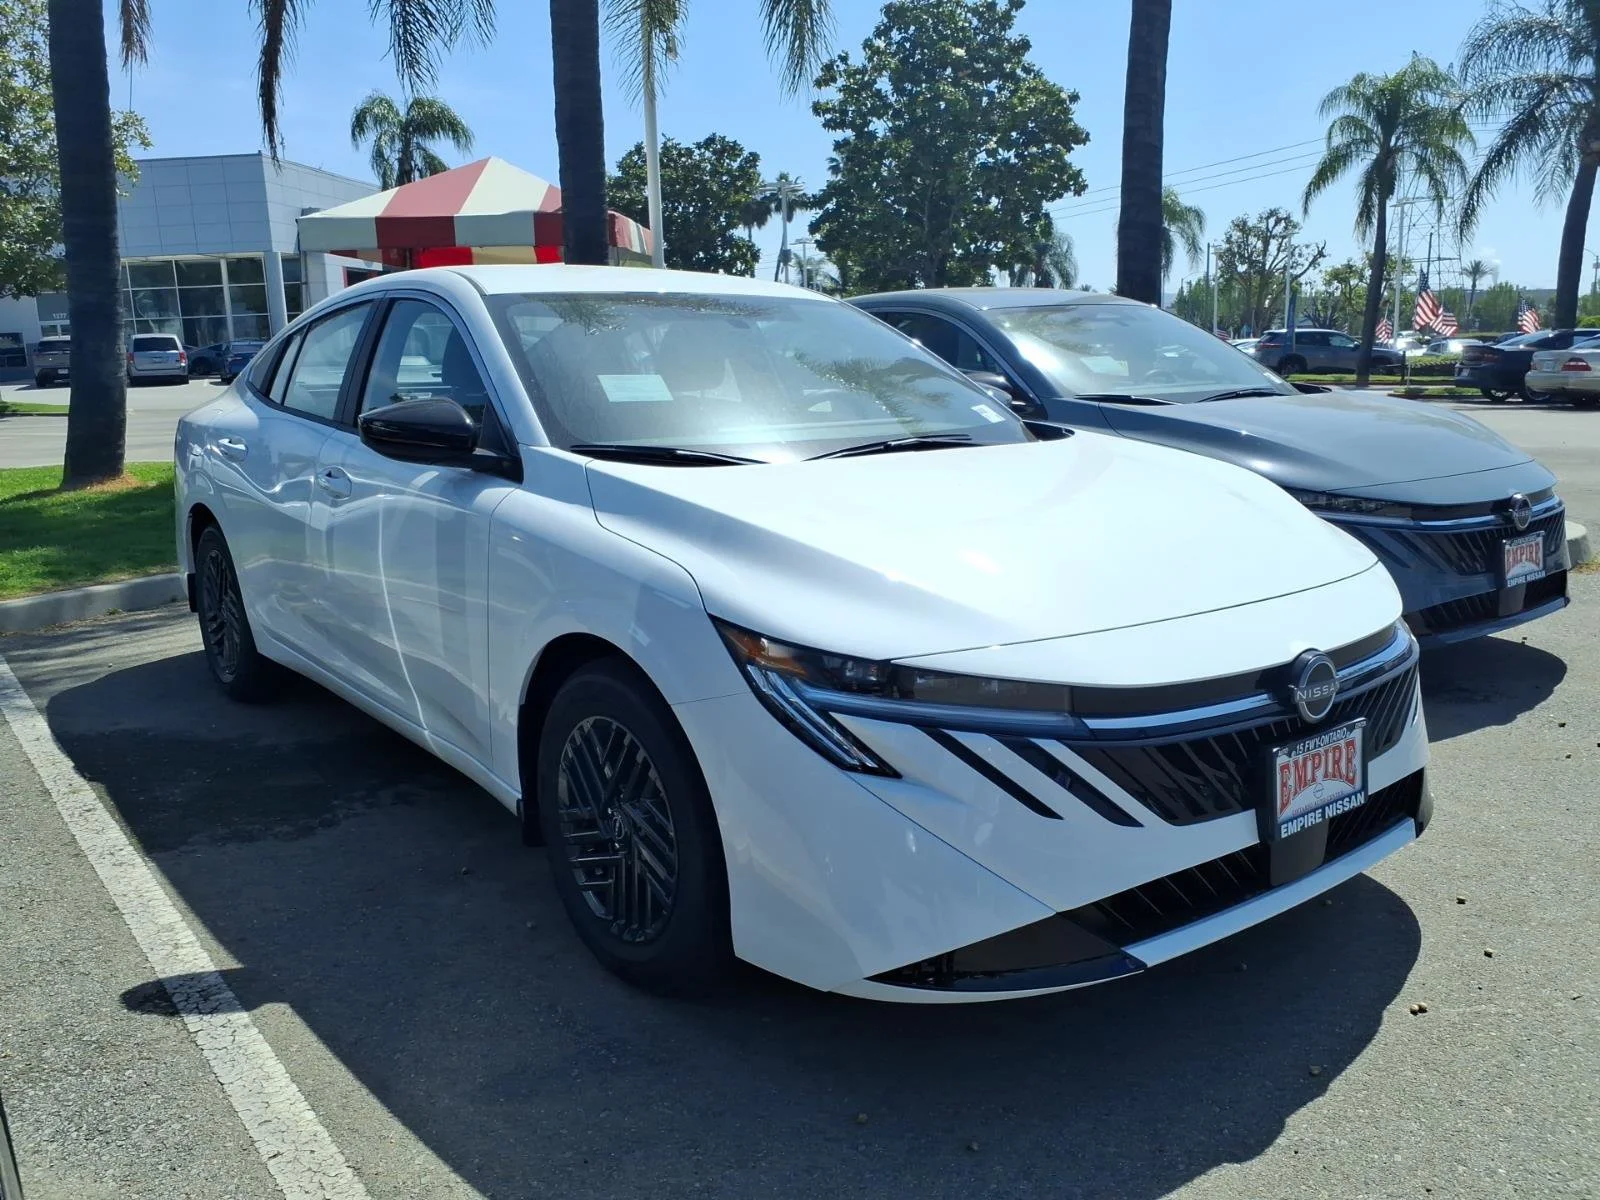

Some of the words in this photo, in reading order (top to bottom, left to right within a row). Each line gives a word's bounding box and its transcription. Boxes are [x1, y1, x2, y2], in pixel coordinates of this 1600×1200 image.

[1279, 738, 1356, 817] EMPIRE
[1281, 809, 1322, 839] EMPIRE
[1325, 791, 1365, 819] NISSAN
